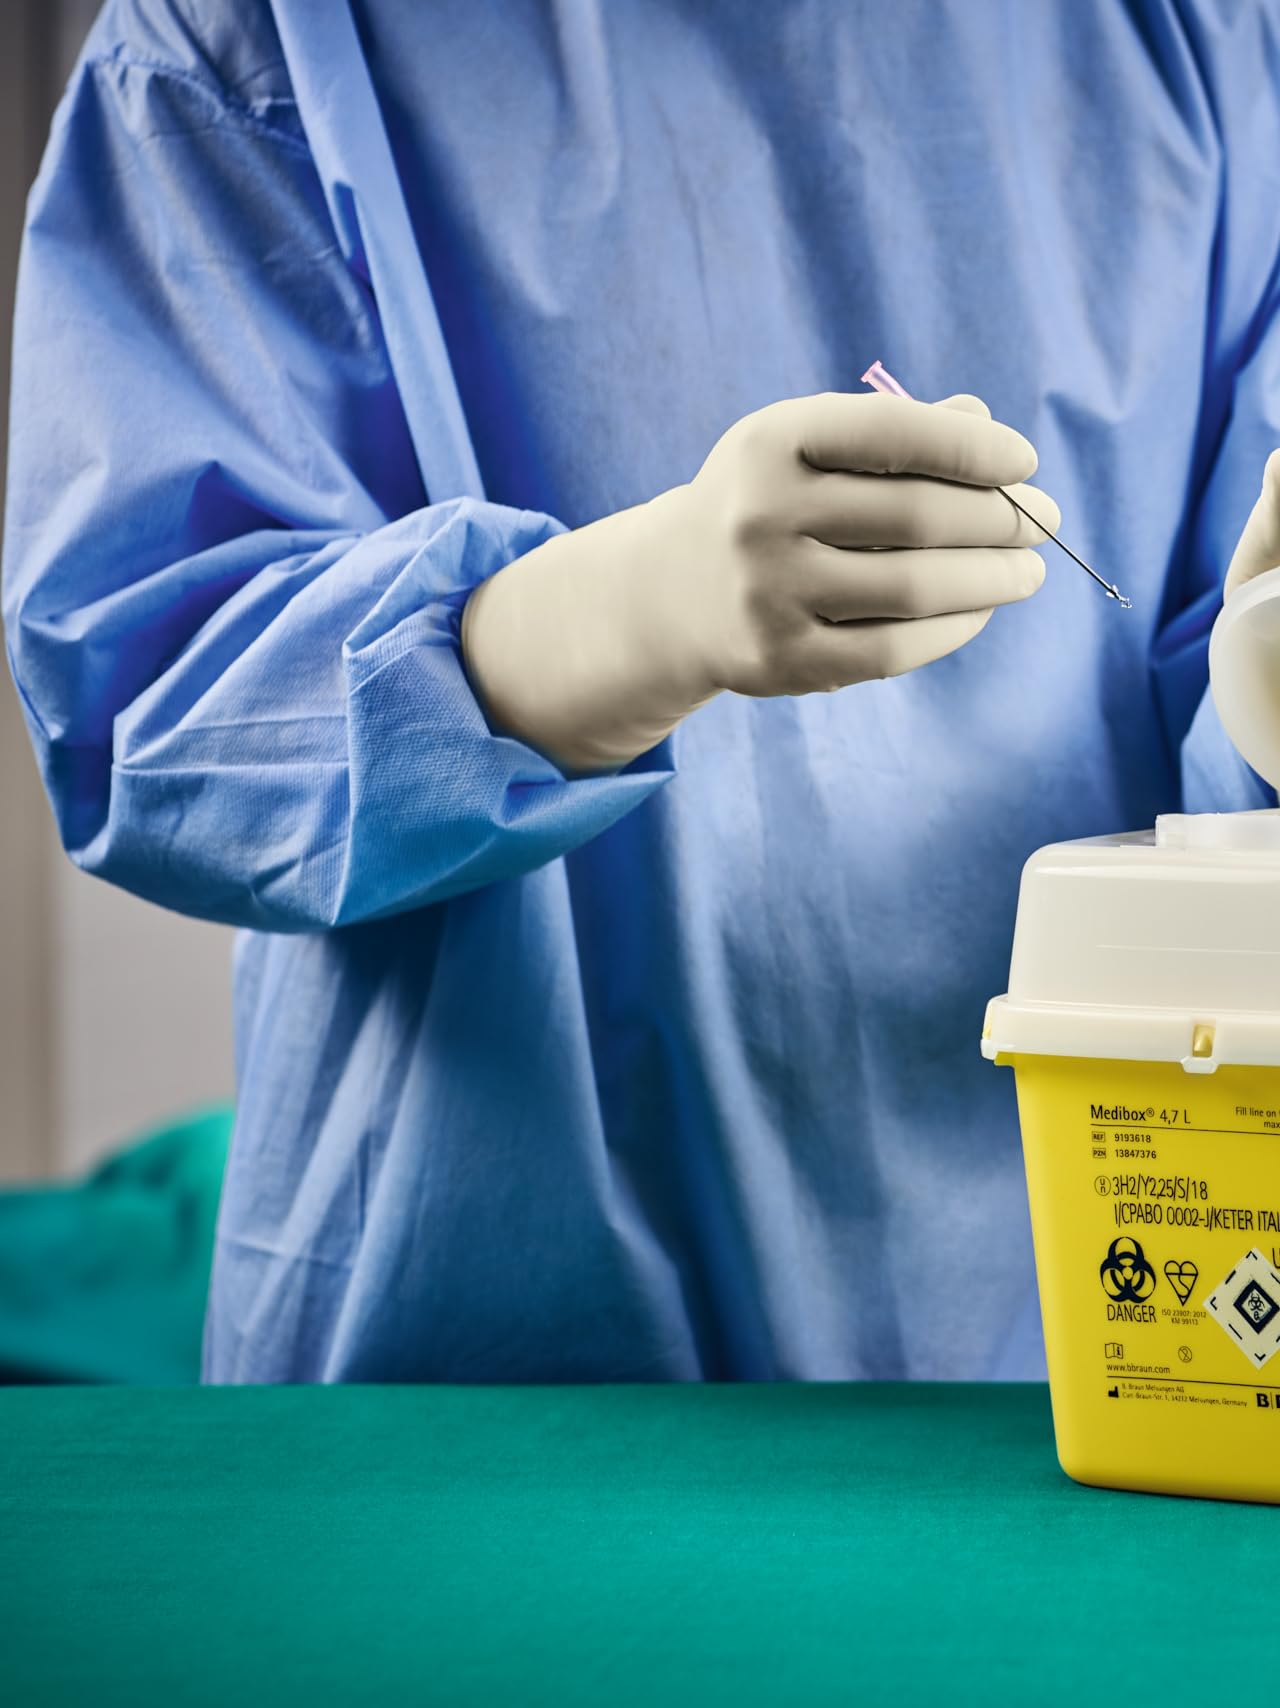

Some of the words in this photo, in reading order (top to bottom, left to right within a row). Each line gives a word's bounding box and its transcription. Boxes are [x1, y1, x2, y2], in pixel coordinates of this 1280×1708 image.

[1160, 1109, 1179, 1125] 4,7
[1184, 1110, 1191, 1124] L
[1235, 1106, 1247, 1116] Fill
[1249, 1107, 1264, 1117] line
[1266, 1110, 1276, 1118] on
[1114, 1133, 1151, 1143] 9193618
[1115, 1149, 1157, 1159] 13847376
[1166, 1206, 1253, 1232] 0002-J/KETER
[1107, 1304, 1157, 1323] DANGER
[1161, 1308, 1171, 1316] ISO
[1106, 1363, 1171, 1374] www.bbraun.com
[1222, 1398, 1248, 1407] Germany
